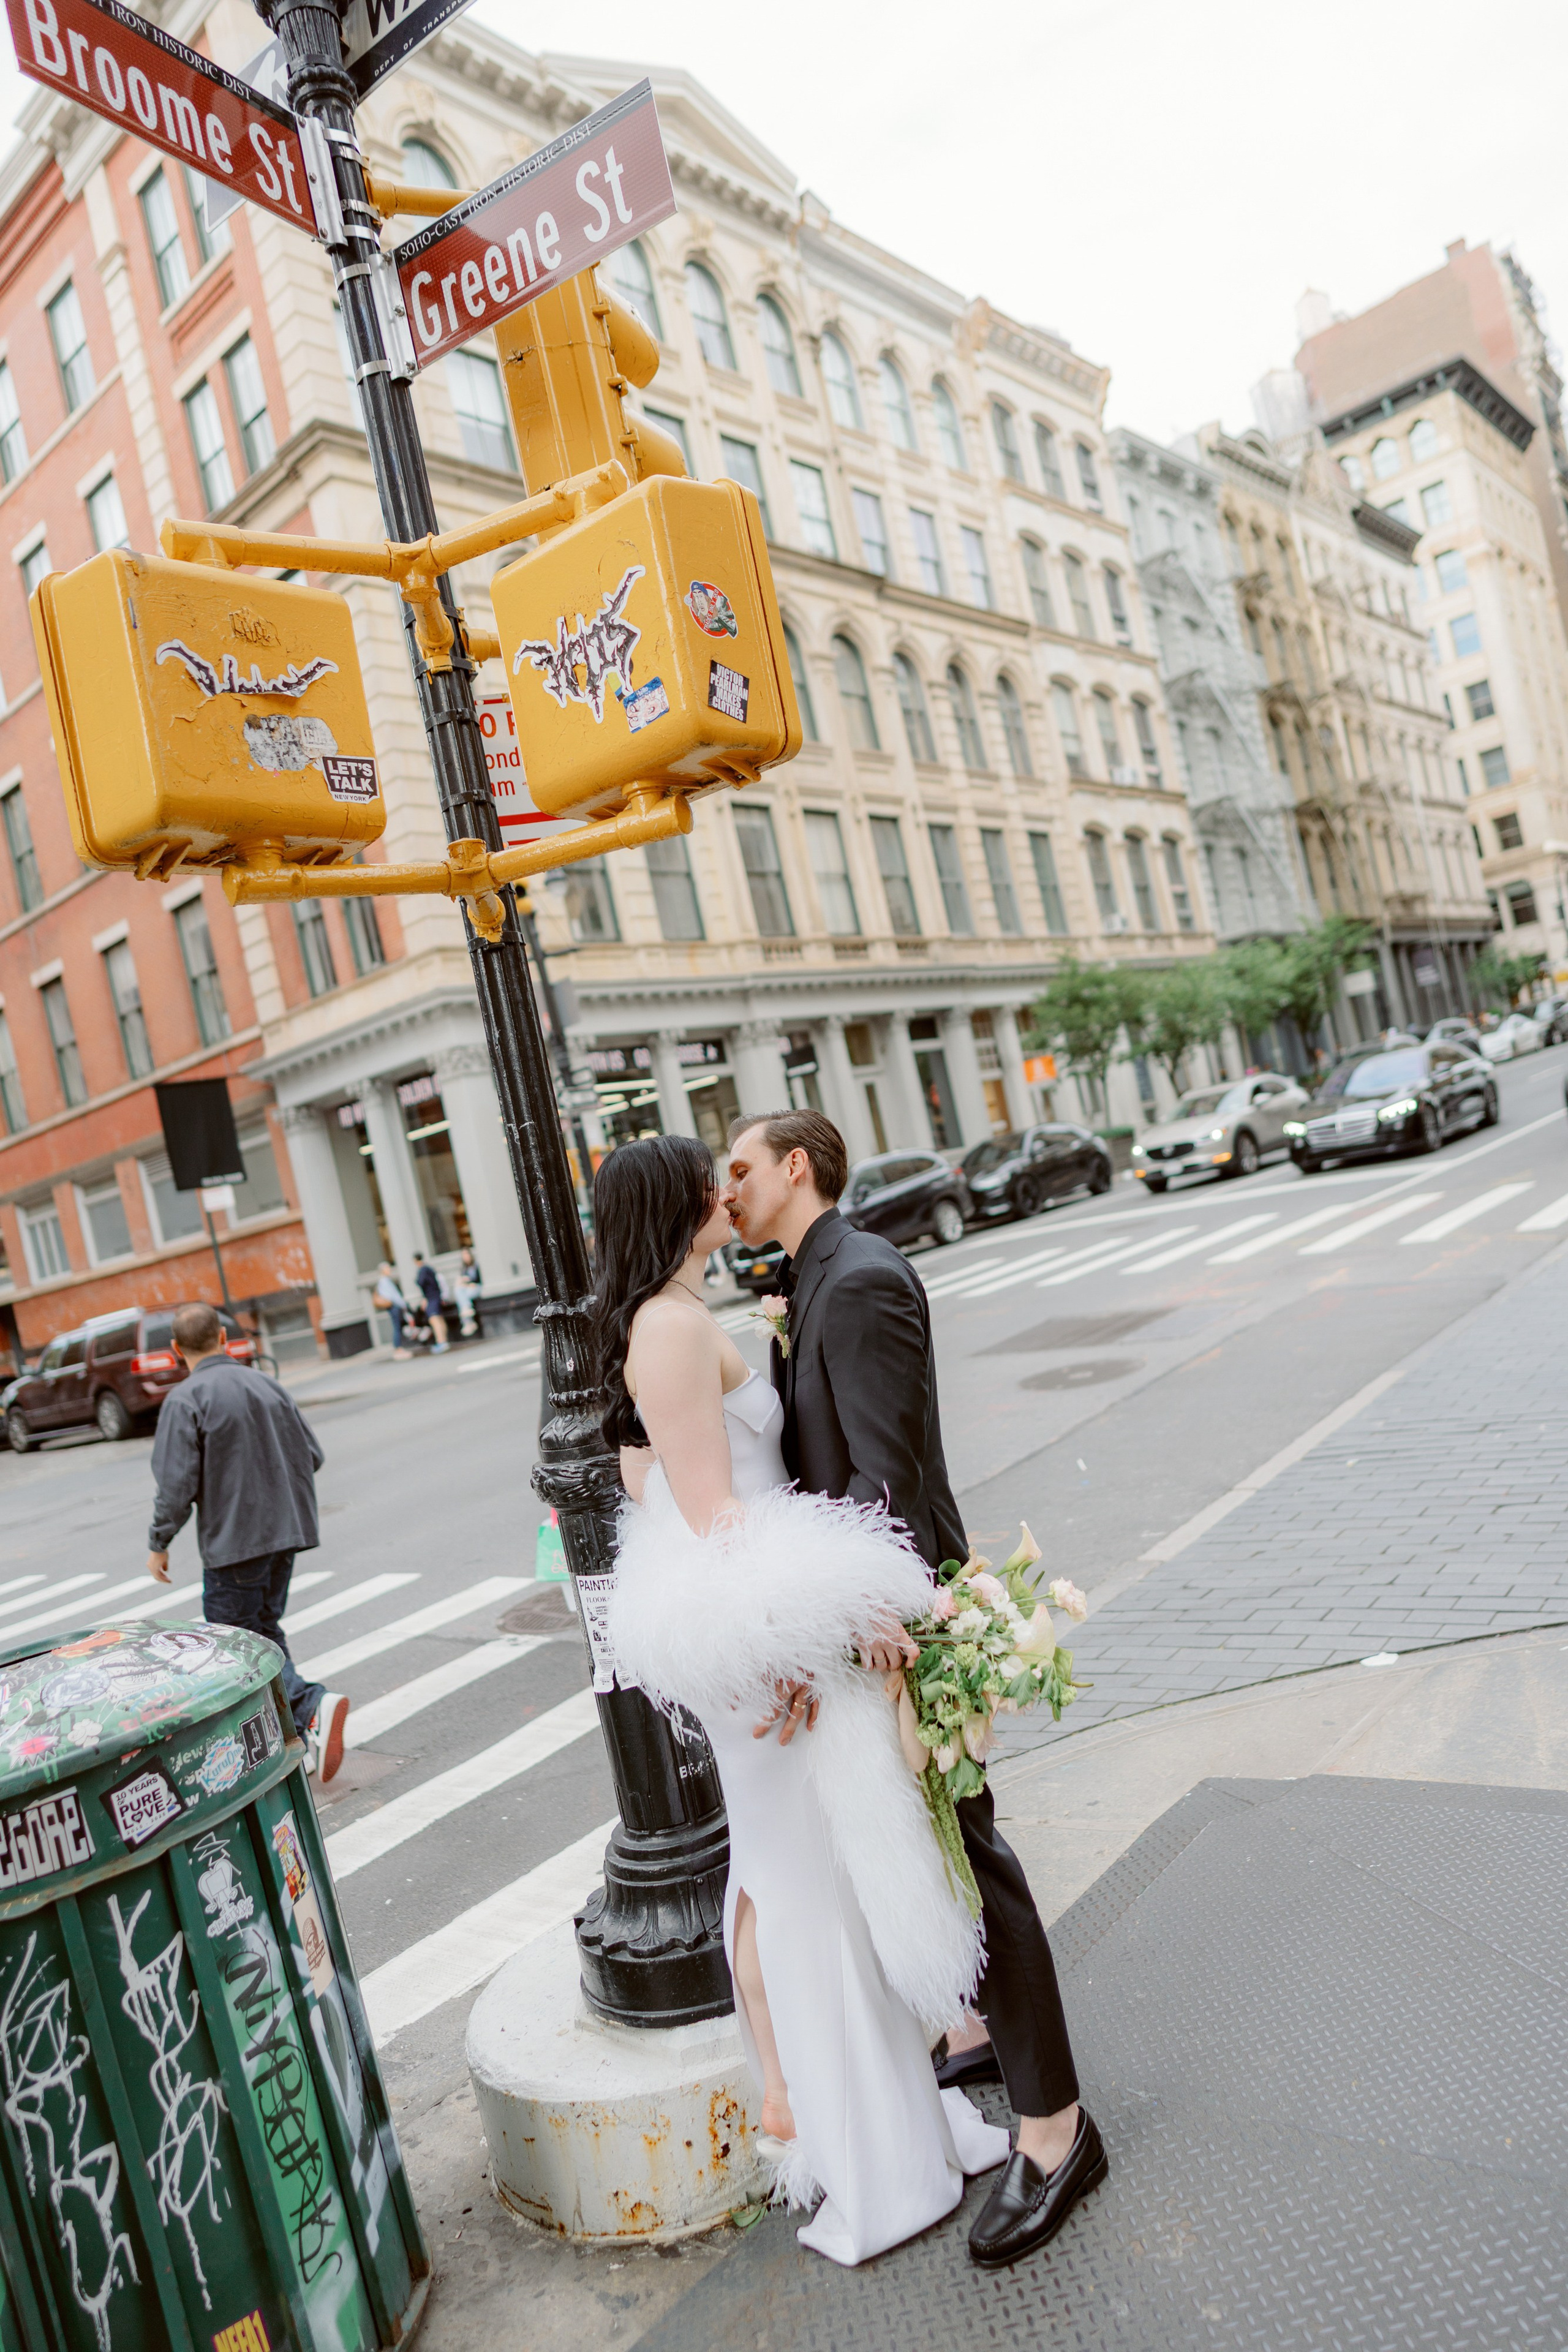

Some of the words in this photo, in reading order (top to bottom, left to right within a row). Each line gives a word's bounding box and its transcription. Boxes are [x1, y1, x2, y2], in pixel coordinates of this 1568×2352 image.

[110, 1, 147, 34] IRON
[153, 28, 218, 79] HISTORIC
[222, 73, 252, 100] DIST
[375, 55, 394, 77] DEPT
[404, 37, 413, 51] OF
[24, 0, 233, 174] Broome
[249, 123, 302, 214] St
[400, 208, 464, 260] SOHO-CAST
[467, 186, 497, 216] IRON
[500, 143, 560, 192] HISTORIC
[563, 121, 592, 151] DIST
[411, 211, 562, 347] Greene
[576, 145, 633, 243] St
[710, 672, 748, 701] PEARLMAN
[717, 664, 744, 687] VICTOR
[712, 696, 744, 721] CLOTHES
[716, 687, 742, 709] MAKES
[327, 760, 374, 777] LET'S
[331, 775, 374, 792] TALK
[200, 1746, 243, 1787] KuruOne
[116, 1792, 127, 1801] 10
[128, 1776, 158, 1795] YEARS
[119, 1787, 163, 1817] PURE
